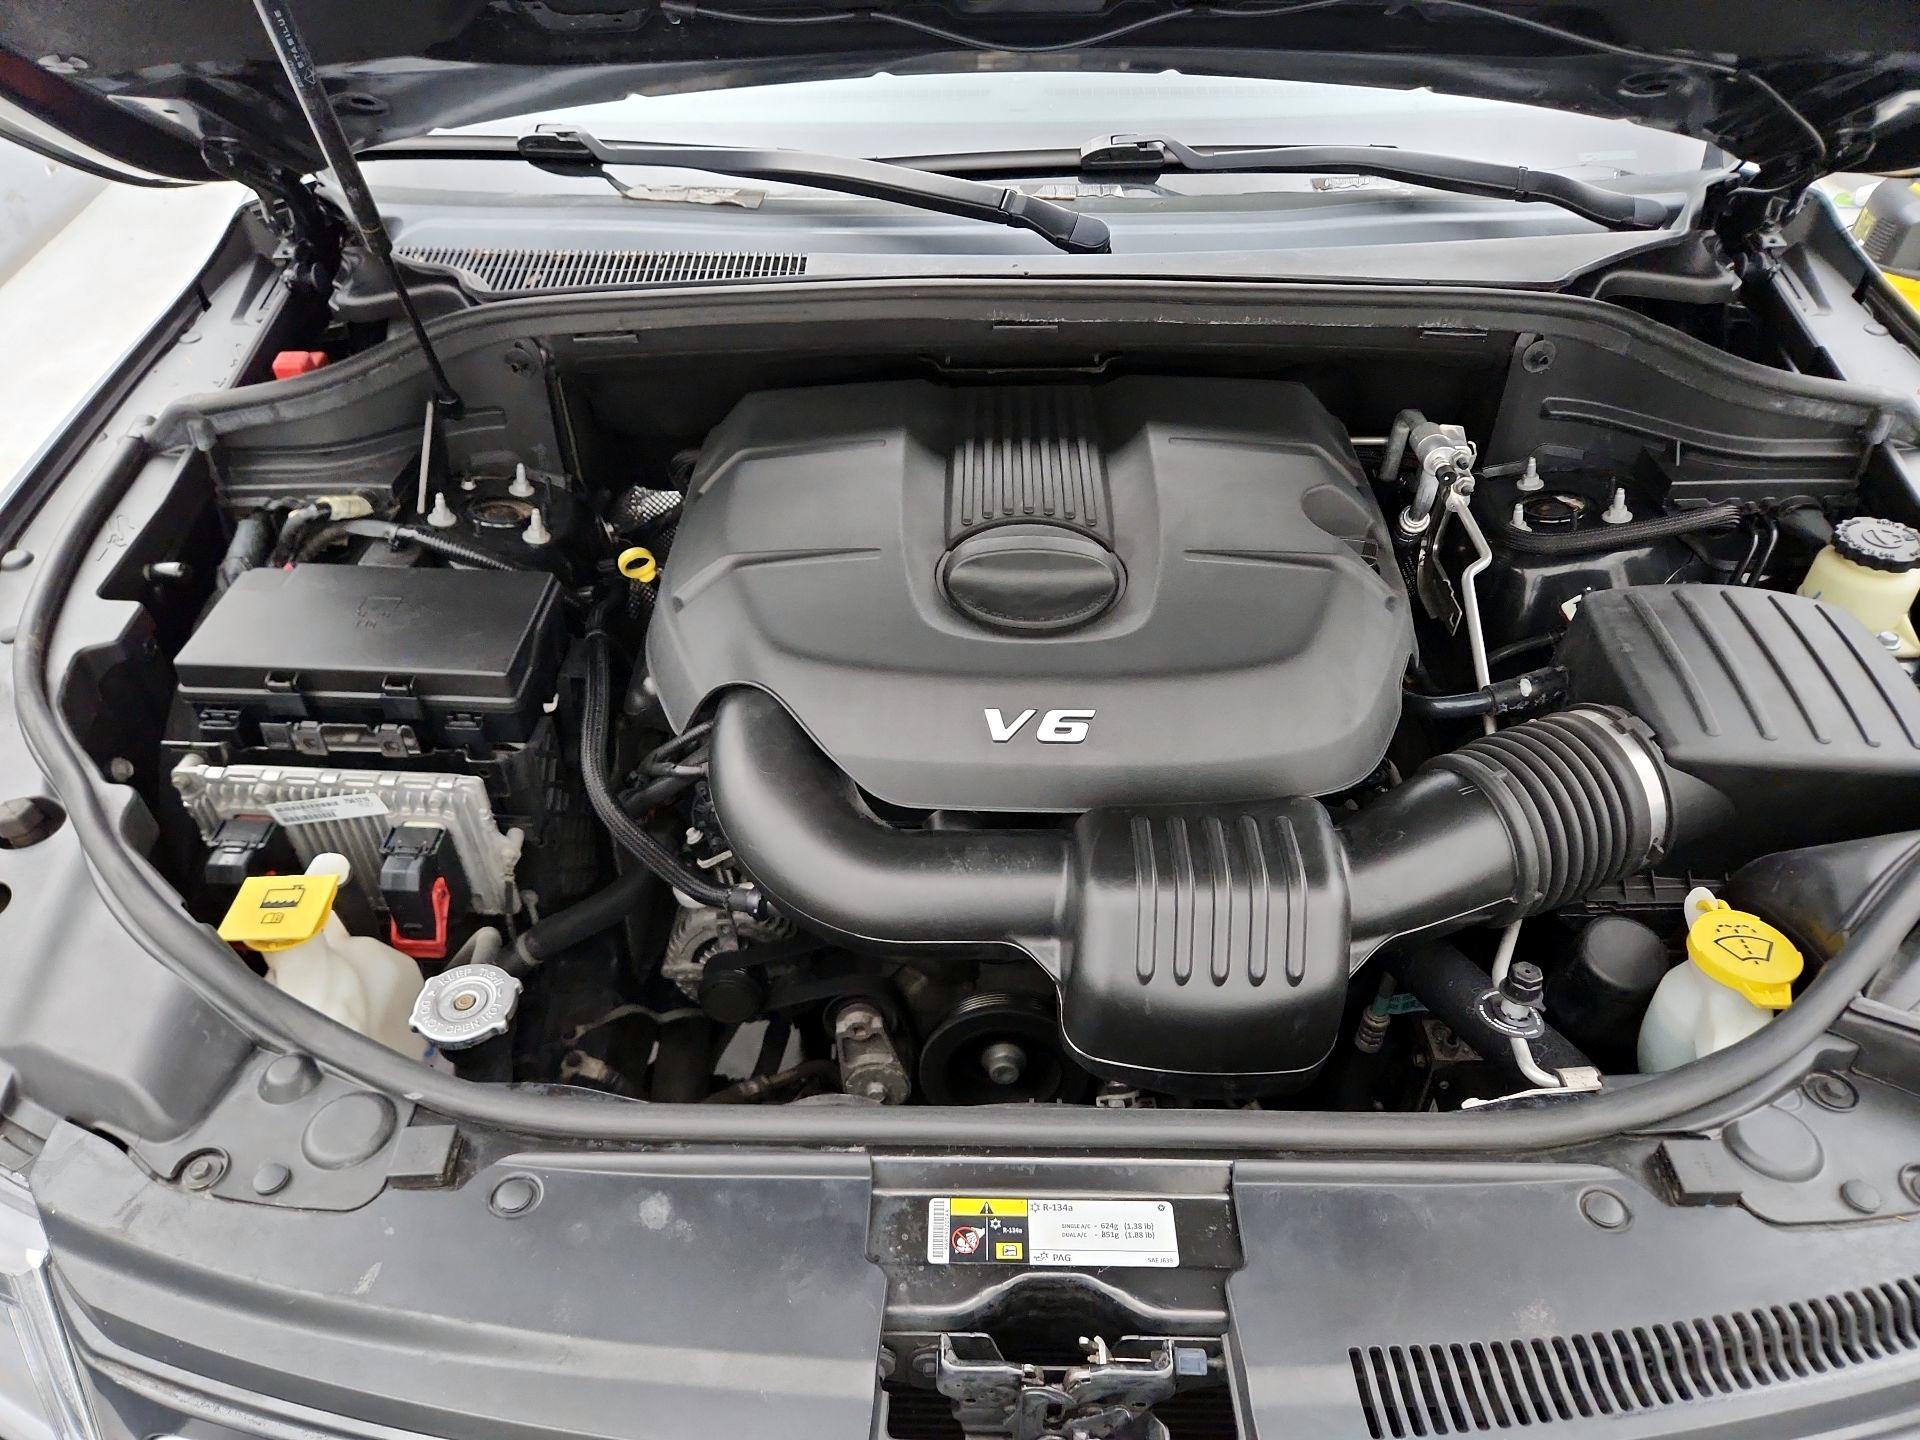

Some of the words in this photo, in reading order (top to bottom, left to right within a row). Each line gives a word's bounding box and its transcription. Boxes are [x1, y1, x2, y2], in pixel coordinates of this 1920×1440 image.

[274, 10, 304, 68] STABILUS
[984, 708, 1097, 744] V6
[439, 968, 472, 986] KEEP
[445, 1020, 481, 1034] OPEN
[1043, 1204, 1073, 1212] R-134a
[1101, 1231, 1120, 1239] 851g
[1052, 1254, 1071, 1262] PAG
